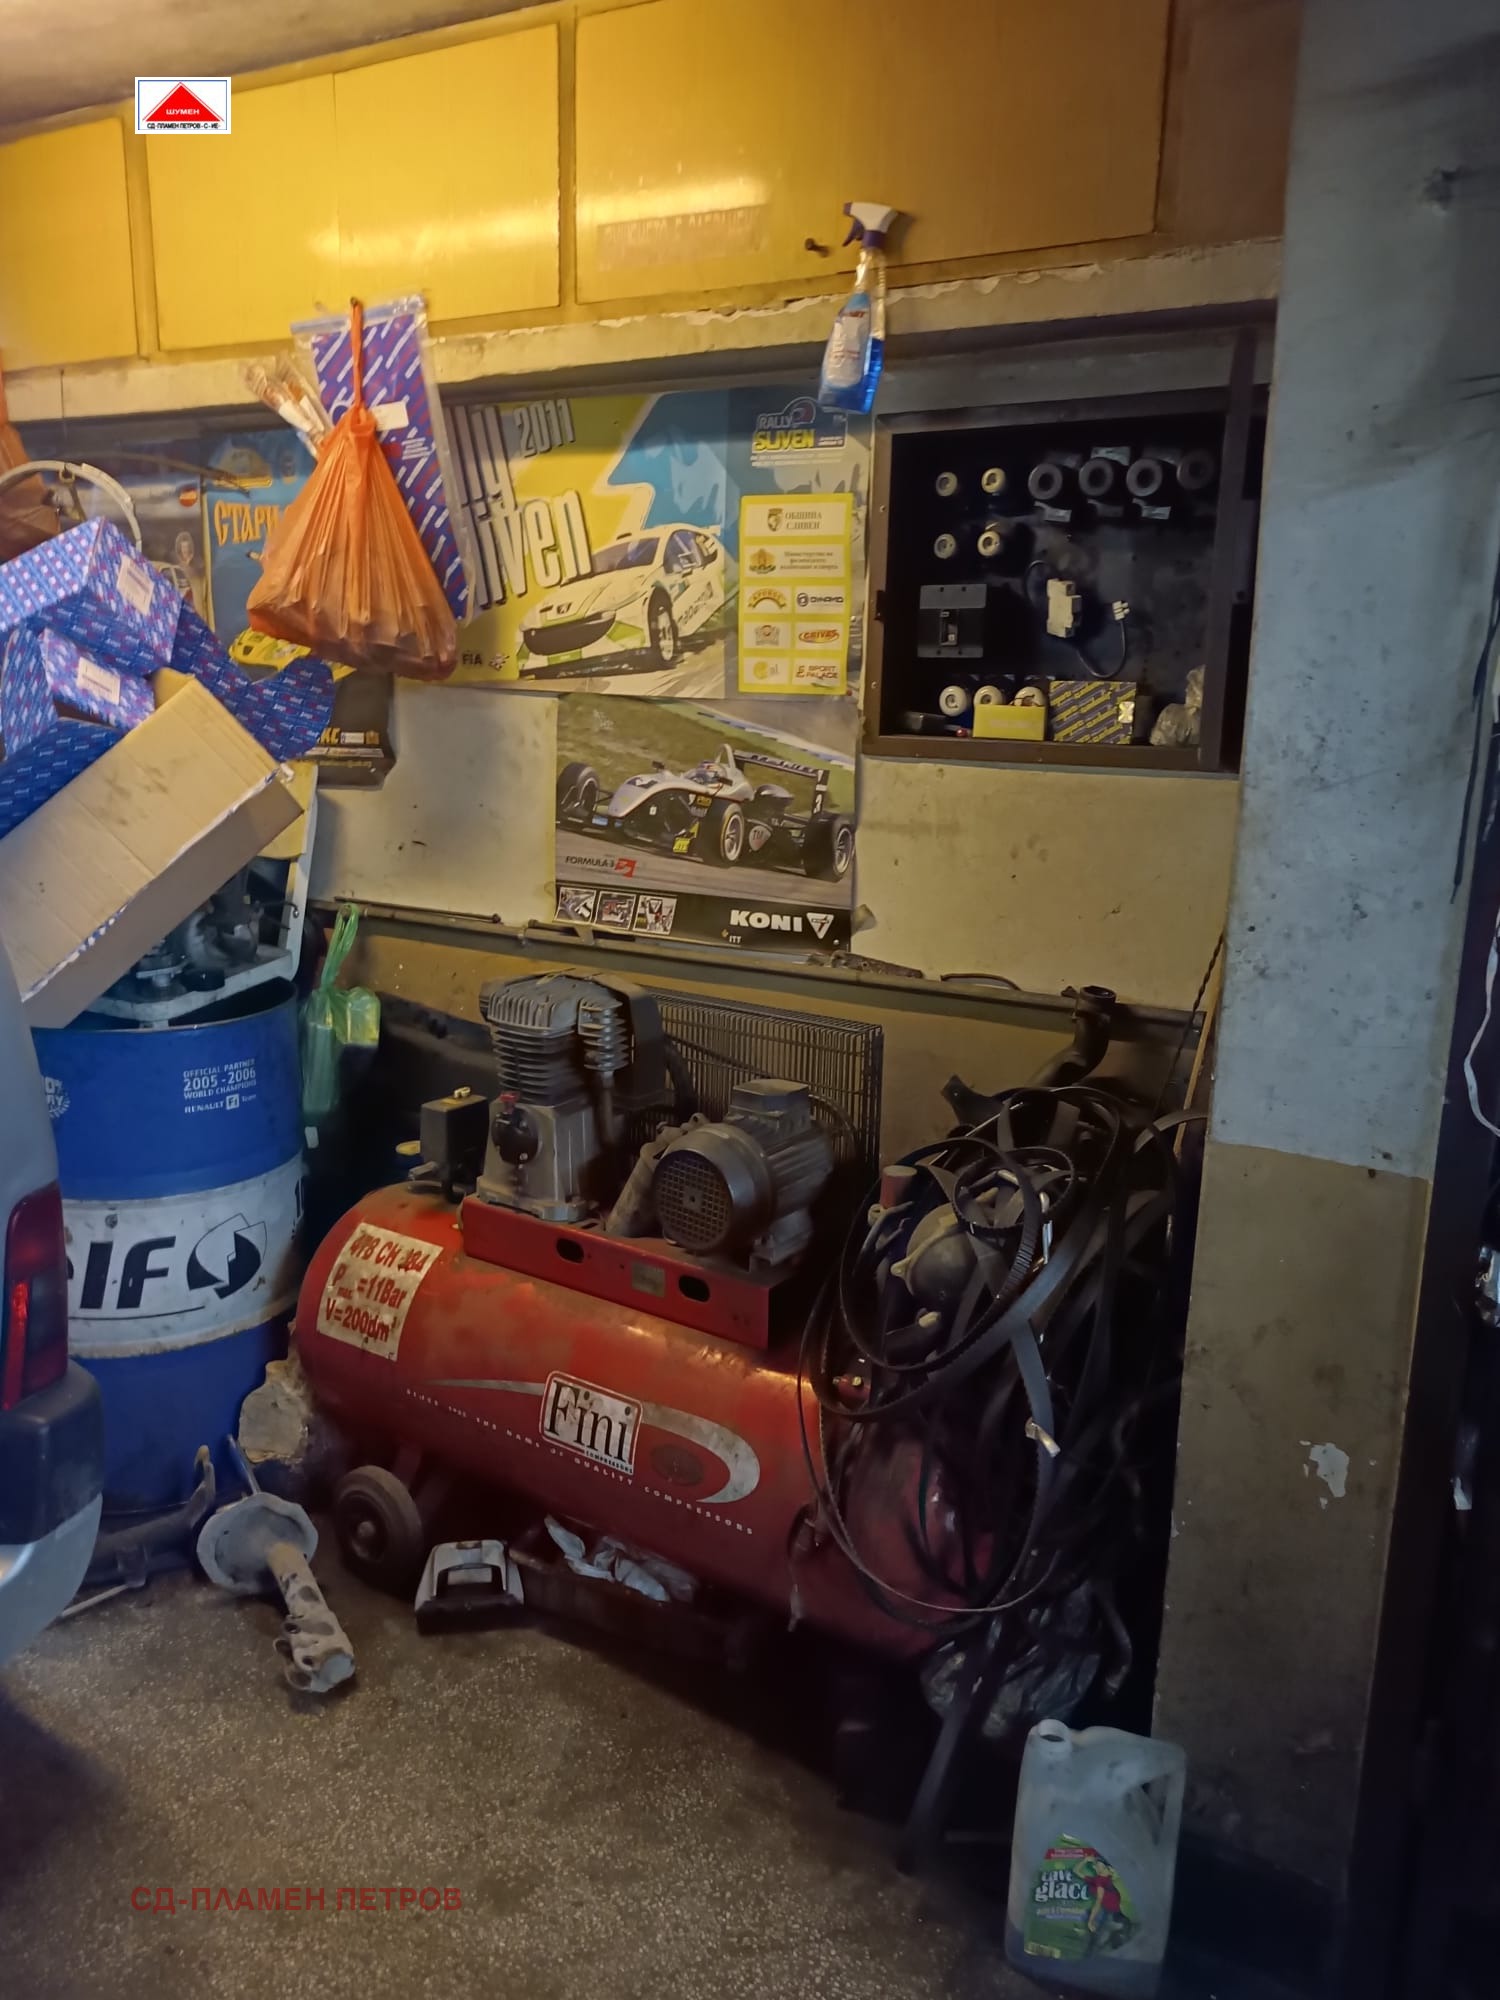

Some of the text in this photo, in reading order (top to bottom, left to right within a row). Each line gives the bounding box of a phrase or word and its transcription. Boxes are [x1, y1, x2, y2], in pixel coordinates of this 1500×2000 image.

[513, 397, 576, 458] 2011
[753, 429, 815, 450] SLIVEN
[462, 652, 483, 665] FIA
[565, 855, 609, 867] FORMULA
[730, 909, 803, 932] KONI
[729, 935, 742, 944] ITT
[183, 1066, 220, 1078] OFFICIAL
[183, 1074, 218, 1092] 2005
[227, 1066, 256, 1084] 2006
[183, 1090, 214, 1100] WORLD
[184, 1101, 225, 1114] RENAULT
[67, 1236, 176, 1310] lf
[545, 1380, 631, 1463] Fini
[574, 1457, 633, 1486] QUALITY
[644, 1485, 753, 1535] COMPRESSORS
